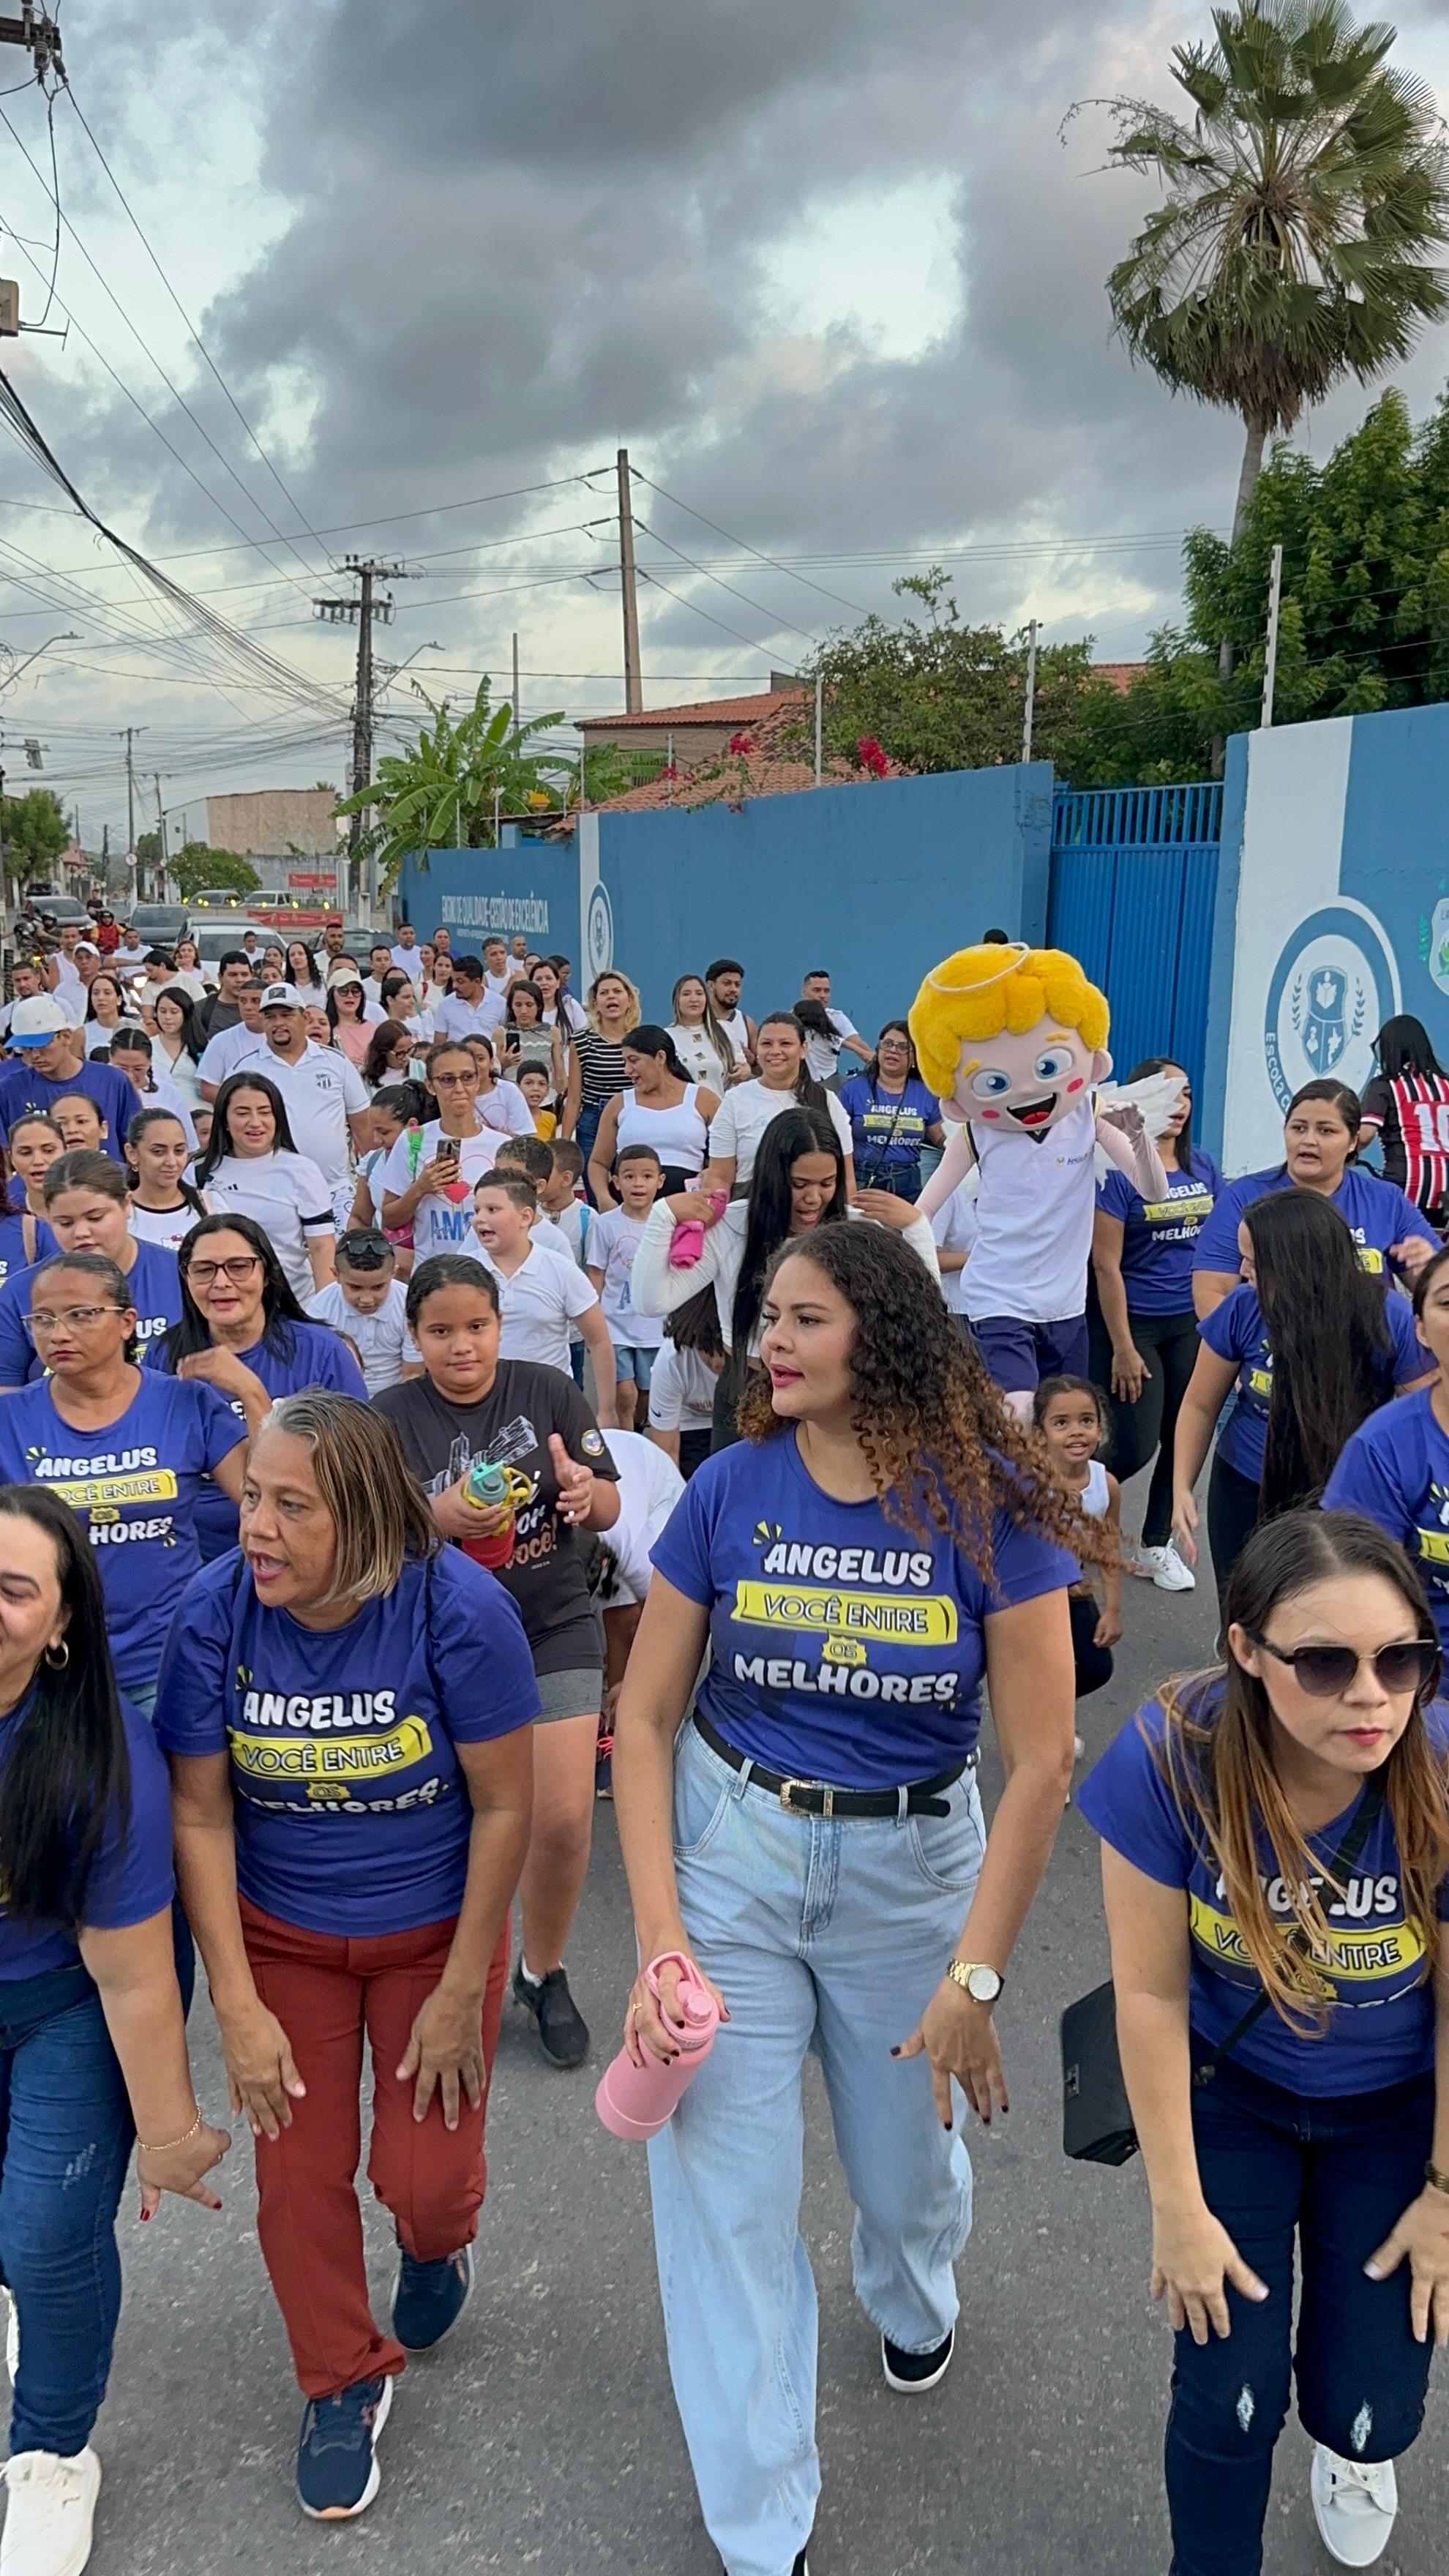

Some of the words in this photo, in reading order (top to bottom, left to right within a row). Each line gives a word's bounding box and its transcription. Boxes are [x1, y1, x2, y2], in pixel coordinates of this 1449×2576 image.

[870, 1104, 918, 1116] ANGELUS
[1165, 1182, 1208, 1199] GELUS
[1151, 1225, 1204, 1241] MELHO
[34, 1447, 158, 1478] ANGELUS
[55, 1483, 97, 1502] OCÊ
[102, 1478, 161, 1499] ENTRE
[94, 1509, 114, 1521] OS
[516, 1504, 546, 1535] or
[89, 1516, 173, 1546] HORES
[763, 1542, 933, 1588] ANGELUS
[763, 1593, 842, 1625] VOCÊ
[847, 1605, 929, 1633] ENTRE
[830, 1641, 858, 1659] OS
[734, 1653, 959, 1704] MELHORES
[242, 1690, 396, 1730] ANGELUS
[241, 1743, 318, 1772] VOCÊ
[323, 1737, 405, 1772] ENTRE
[311, 1785, 342, 1800] OS
